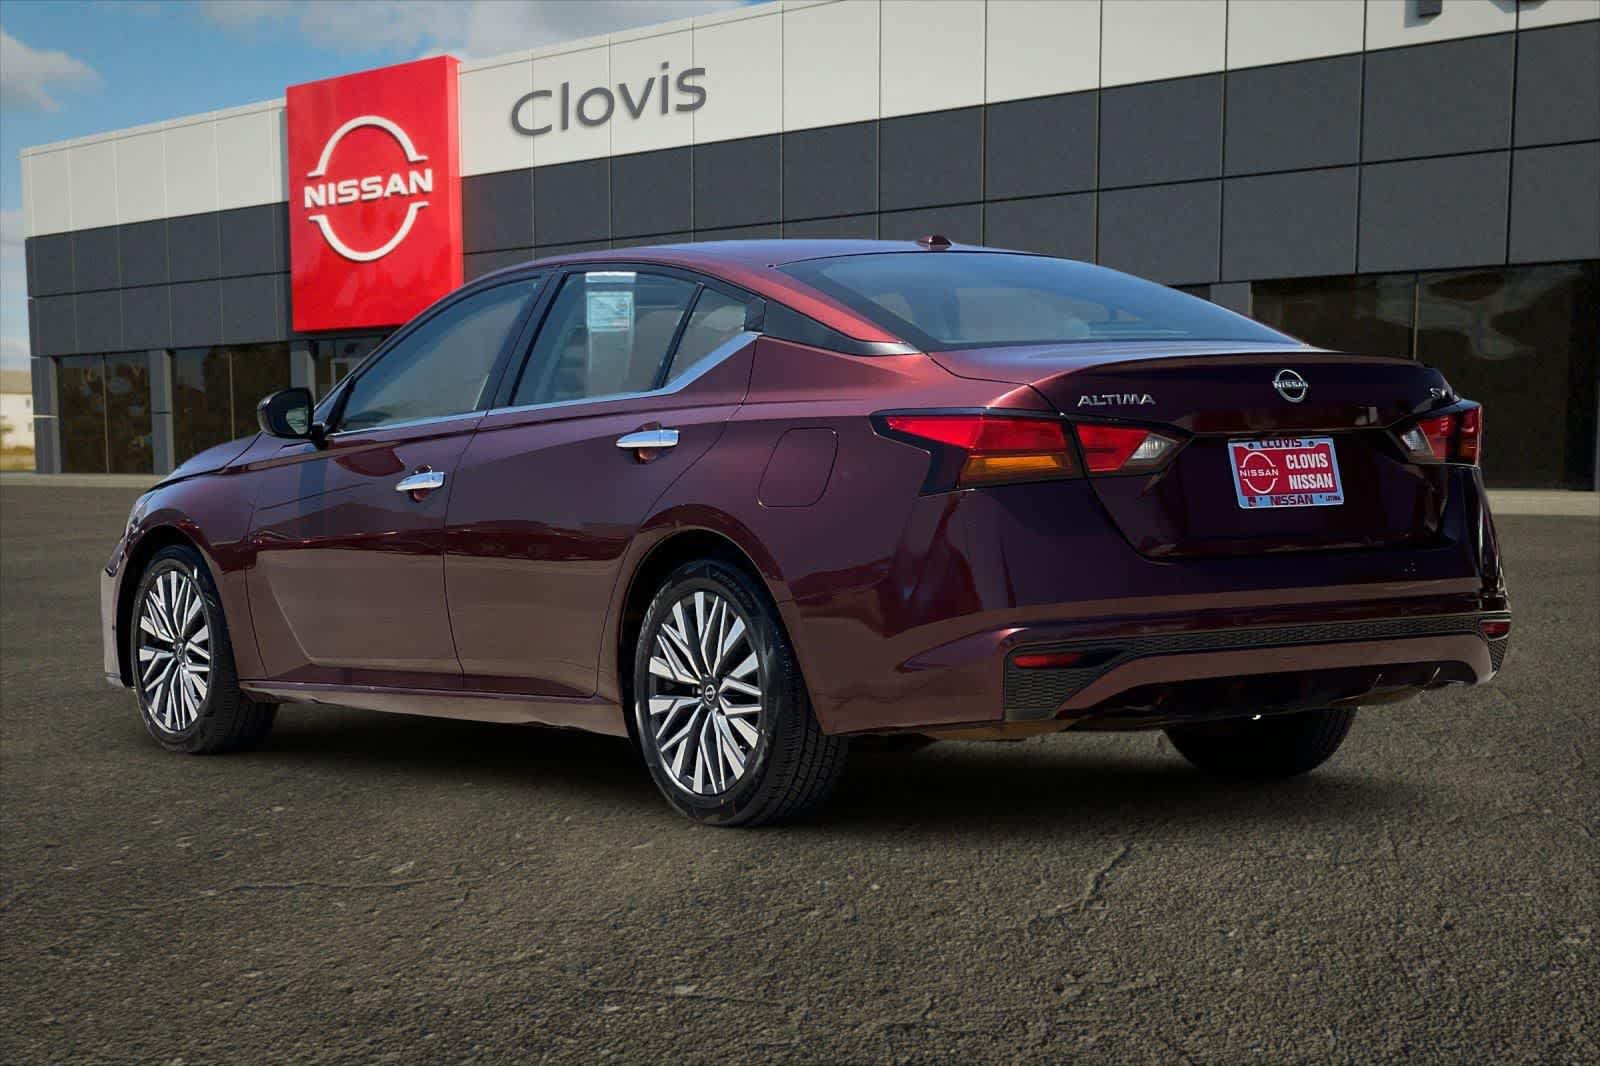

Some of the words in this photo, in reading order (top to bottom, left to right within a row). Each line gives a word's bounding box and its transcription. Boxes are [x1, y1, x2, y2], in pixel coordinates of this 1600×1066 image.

[511, 61, 707, 136] Clovis
[303, 168, 433, 209] NISSAN
[1271, 380, 1309, 389] NISSAN
[1077, 394, 1156, 407] ALTIMA
[1285, 453, 1329, 470] CLOVIS
[1240, 468, 1279, 477] NISSAN
[1288, 473, 1334, 490] NISSAN
[1270, 494, 1313, 506] NISSAN
